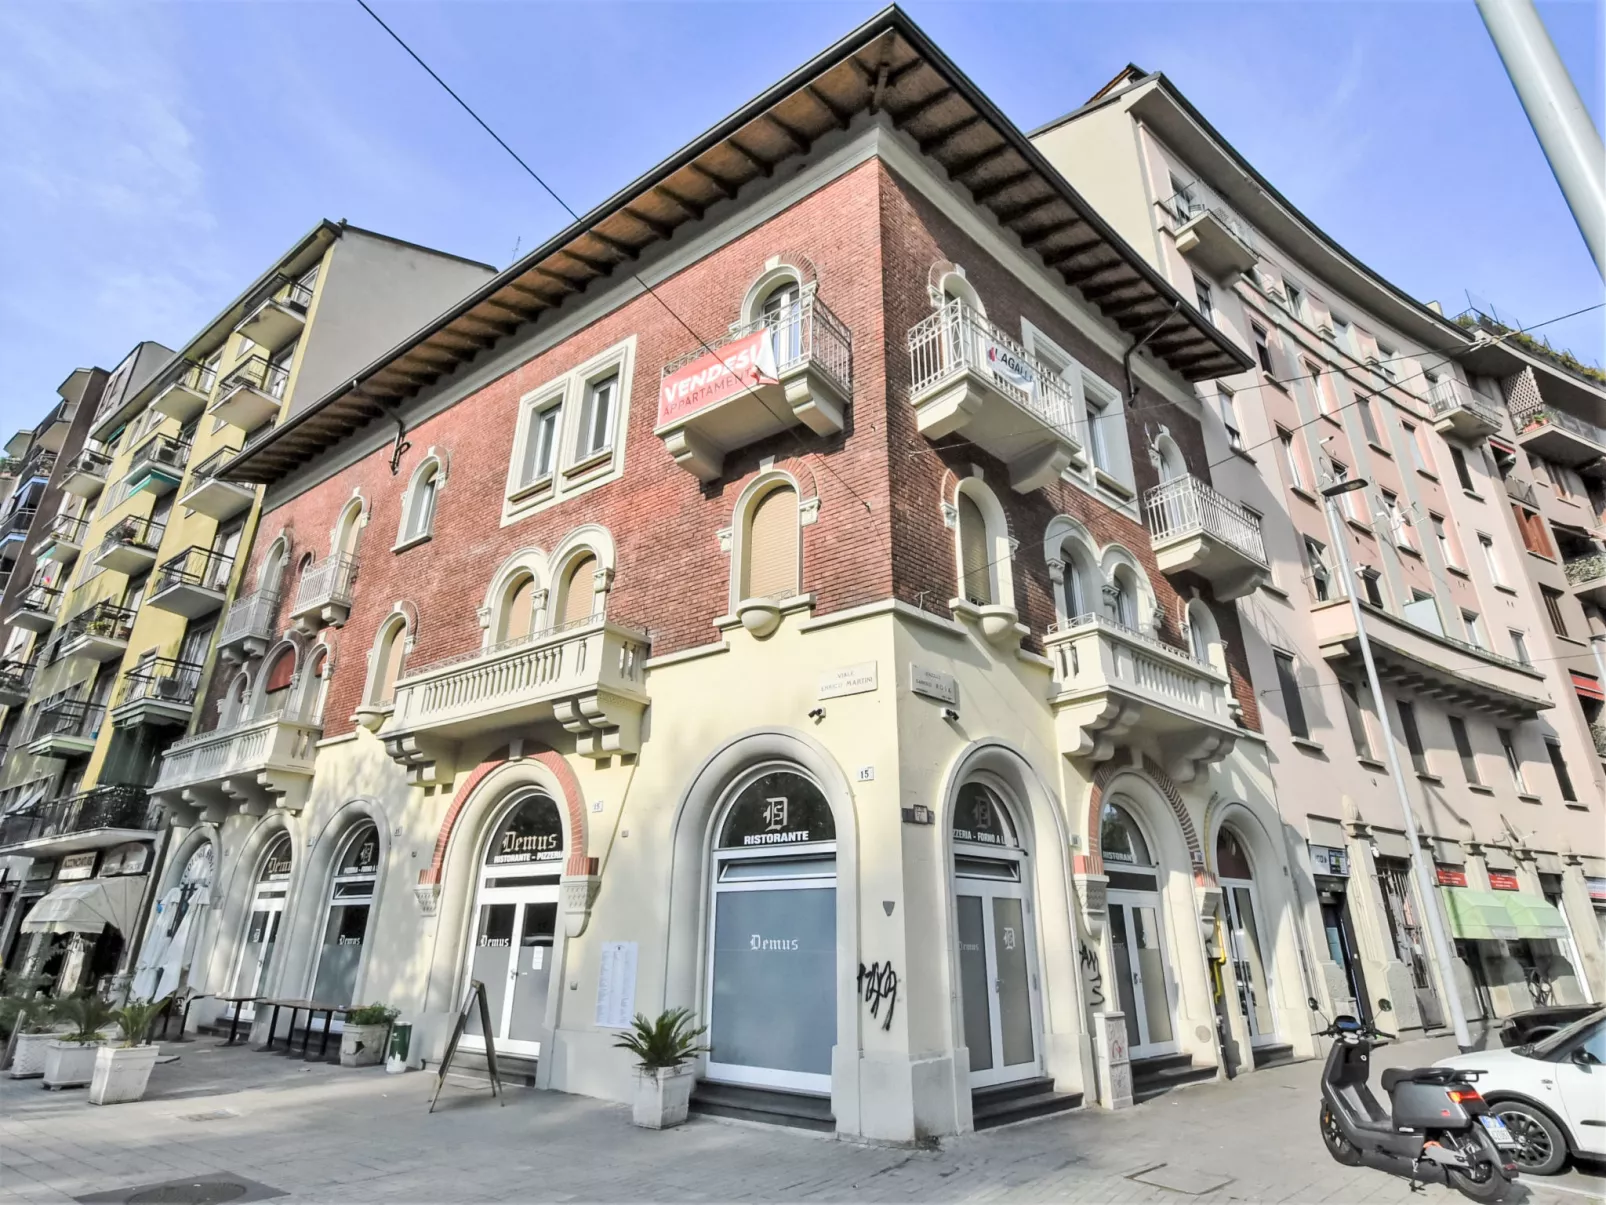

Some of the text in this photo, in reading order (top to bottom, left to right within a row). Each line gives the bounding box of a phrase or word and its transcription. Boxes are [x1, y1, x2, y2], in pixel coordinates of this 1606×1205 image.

[662, 366, 752, 417] APPARTAMENT
[837, 671, 854, 679] VIALE
[821, 676, 873, 692] ENRICO MARTINI
[861, 769, 869, 779] 15
[503, 831, 558, 853] Demus
[744, 830, 809, 845] RISTORANTE
[953, 828, 972, 840] ZZERIA
[977, 832, 995, 843] FORNO
[494, 853, 532, 864] RISTORANTE
[1102, 850, 1132, 862] RISTORAN
[480, 934, 509, 947] Demus
[750, 934, 799, 950] Demus
